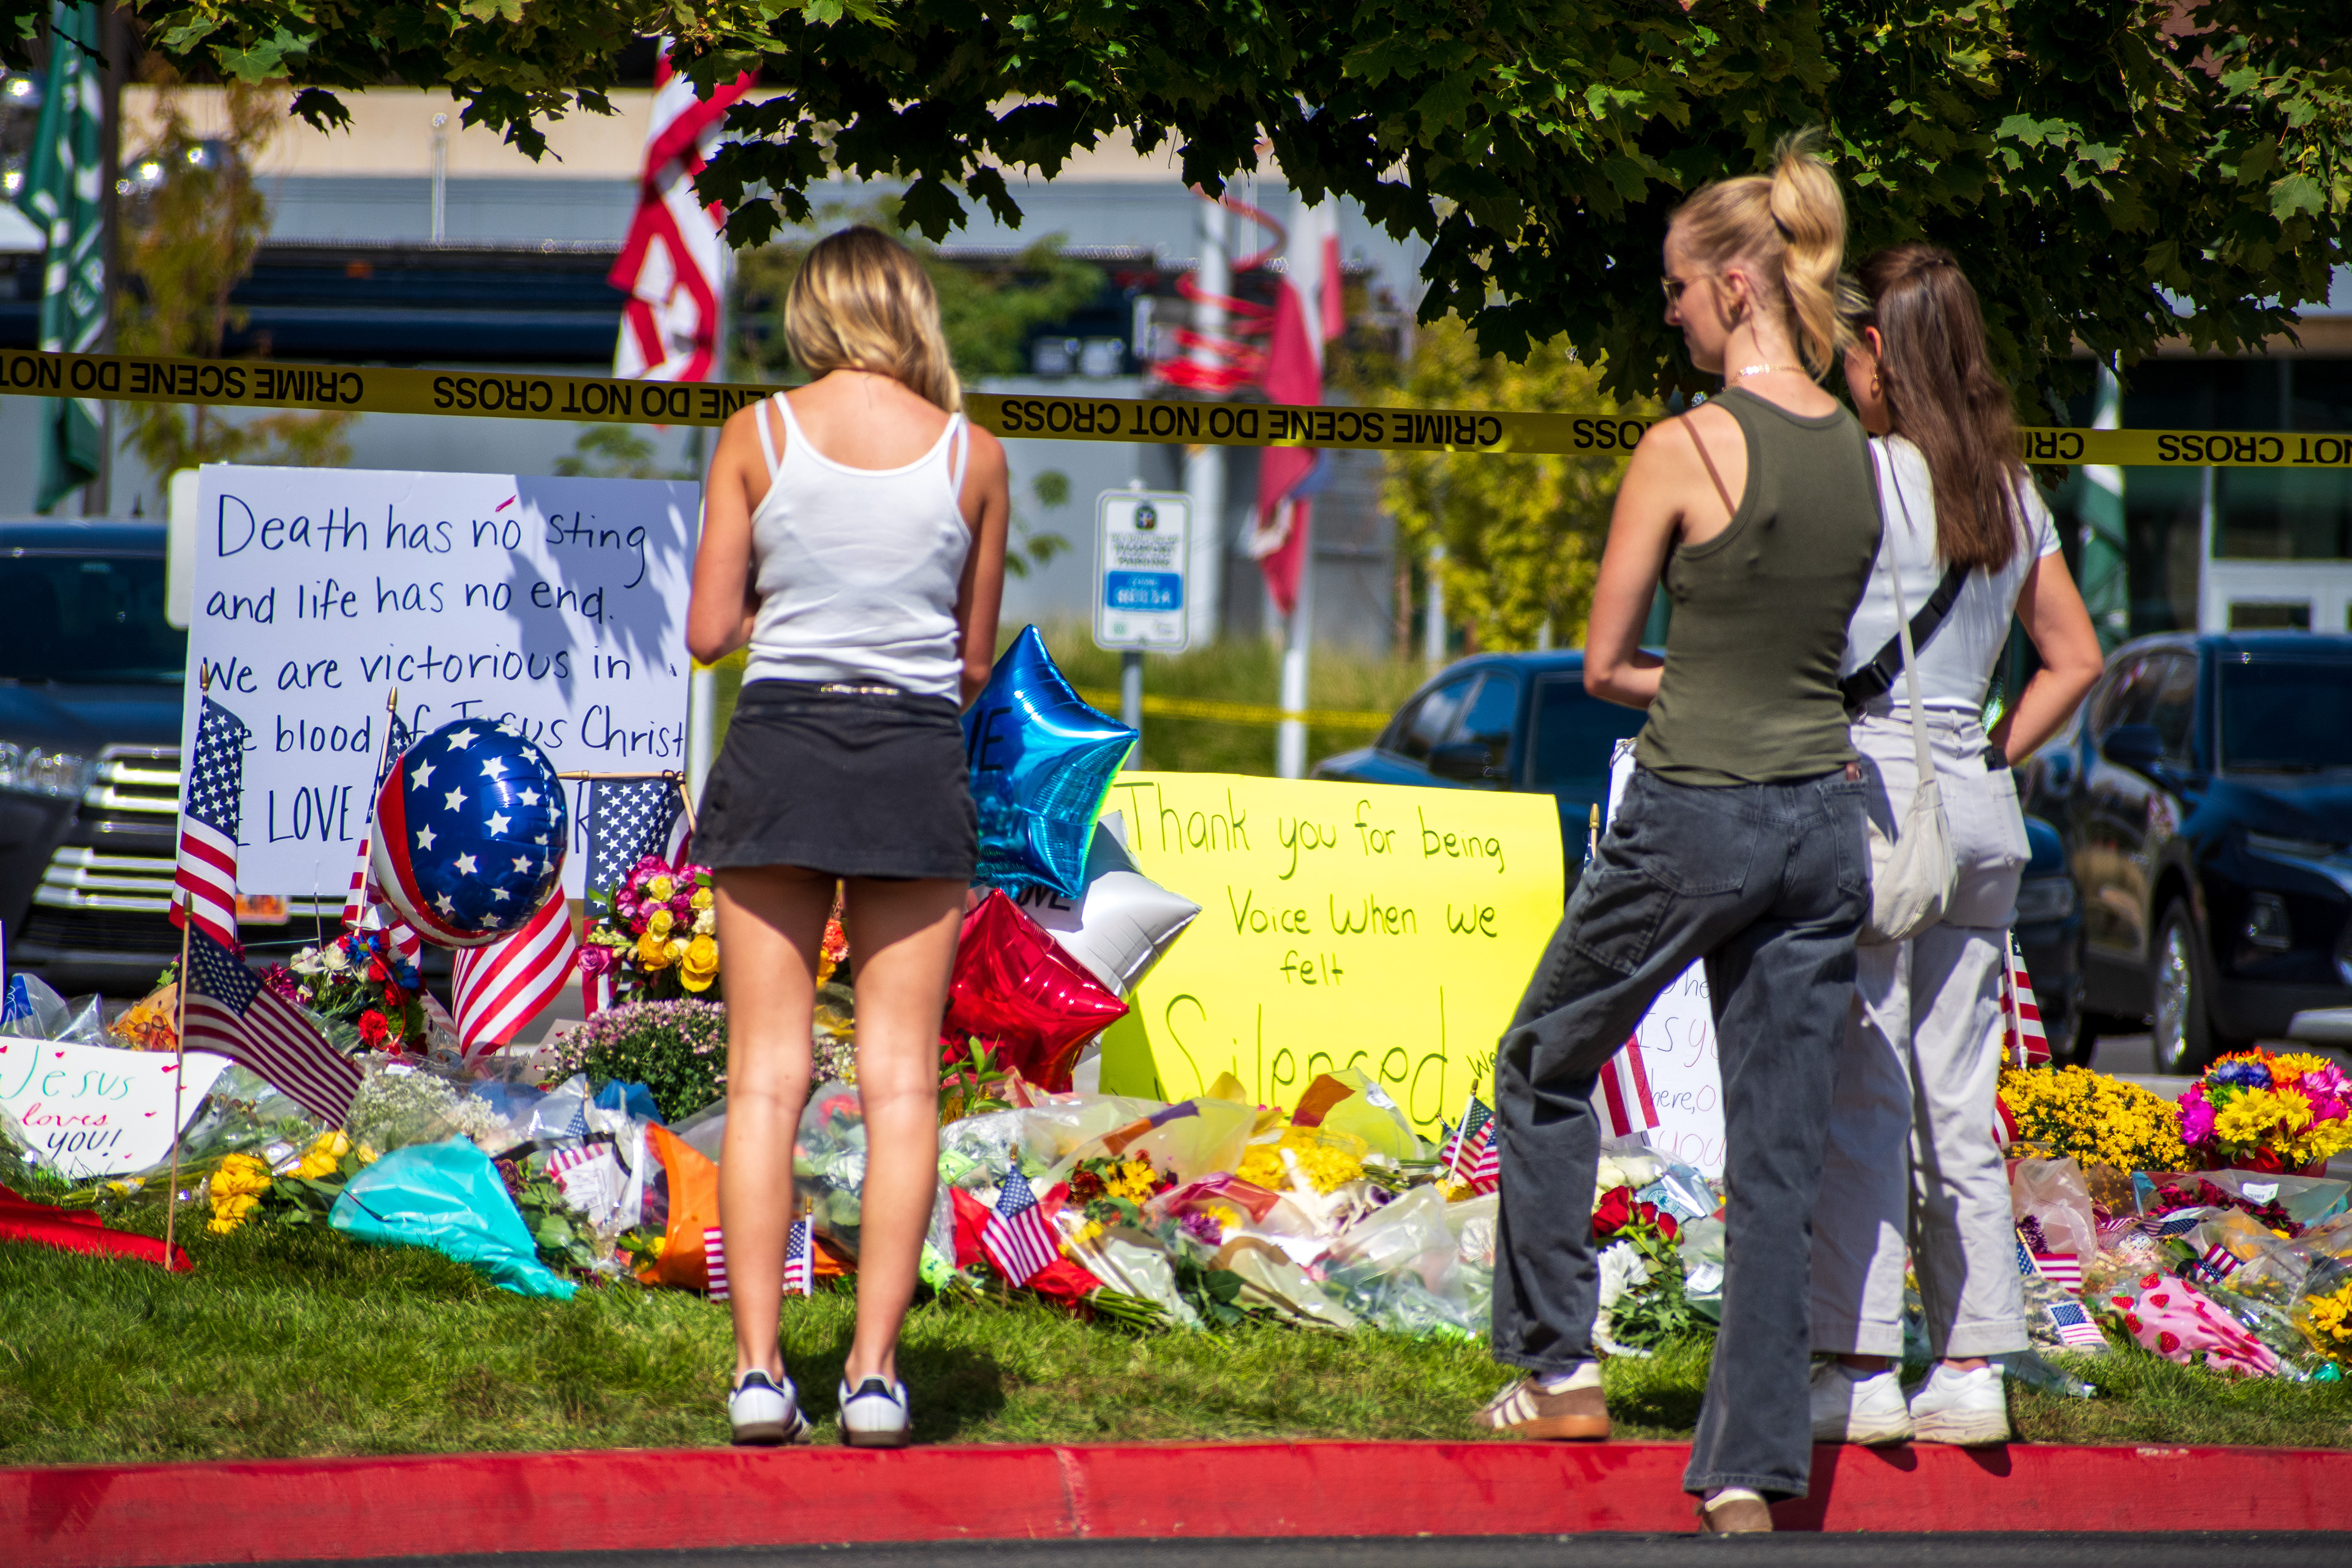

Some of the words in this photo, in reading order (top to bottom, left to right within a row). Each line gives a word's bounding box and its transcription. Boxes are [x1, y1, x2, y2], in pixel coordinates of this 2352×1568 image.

[70, 359, 121, 392] DO
[130, 362, 246, 399] SCENE
[254, 368, 364, 404] CRIME
[433, 376, 553, 412] CROSS
[560, 382, 631, 415] NOT
[641, 386, 690, 418] DO
[1001, 399, 1121, 434] CROSS
[1129, 405, 1199, 437] NOT
[1208, 407, 1259, 439] DO
[1267, 410, 1384, 443] SCENE
[1392, 413, 1502, 446] CRIME
[1570, 417, 1652, 450] OSS
[2157, 434, 2284, 463] CROSS
[218, 494, 367, 557] Death
[386, 503, 453, 553] has
[472, 519, 521, 551] no
[541, 511, 646, 592] sting
[206, 587, 275, 624] and
[299, 578, 358, 620] life
[377, 576, 443, 613] has
[466, 582, 512, 611] no
[530, 581, 614, 625] end.
[203, 654, 260, 695] We
[277, 659, 342, 690] are
[360, 645, 569, 683] victorious
[594, 645, 631, 680] in
[276, 714, 371, 753] blood
[409, 704, 431, 744] f
[581, 704, 684, 758] Christ
[269, 785, 353, 843] LOVE
[1112, 781, 1251, 855] Thank
[1278, 820, 1336, 880] you
[1355, 799, 1395, 854] for
[1419, 807, 1504, 874] being
[1228, 886, 1310, 935] Voice
[1447, 905, 1497, 938] we
[1280, 950, 1343, 985] felt
[0, 1044, 136, 1100] Jesus
[23, 1102, 108, 1127] loves
